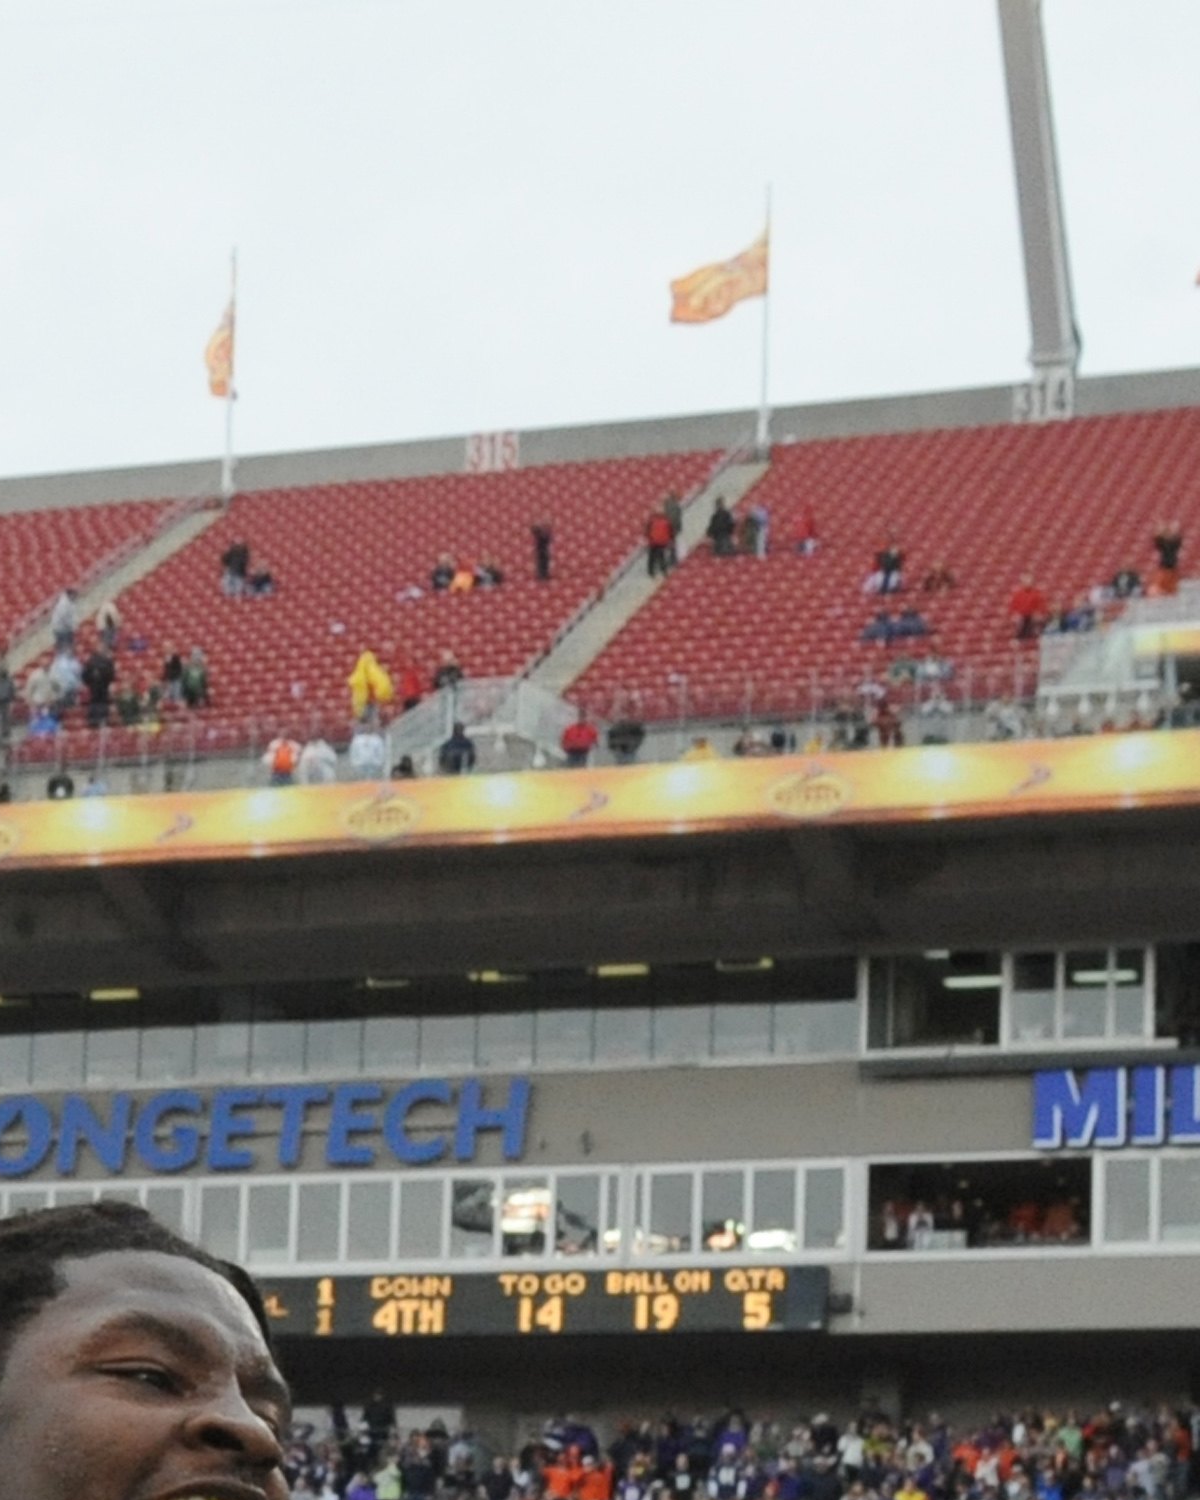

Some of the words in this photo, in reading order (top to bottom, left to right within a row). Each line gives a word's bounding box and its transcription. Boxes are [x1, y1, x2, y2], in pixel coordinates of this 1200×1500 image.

[466, 432, 518, 471] 315
[498, 1274, 538, 1295] TO
[544, 1272, 586, 1295] GO
[606, 1271, 668, 1294] BALL
[373, 1300, 445, 1335] 4TH
[519, 1297, 562, 1333] 14
[635, 1294, 679, 1331] 19
[743, 1292, 771, 1330] 5
